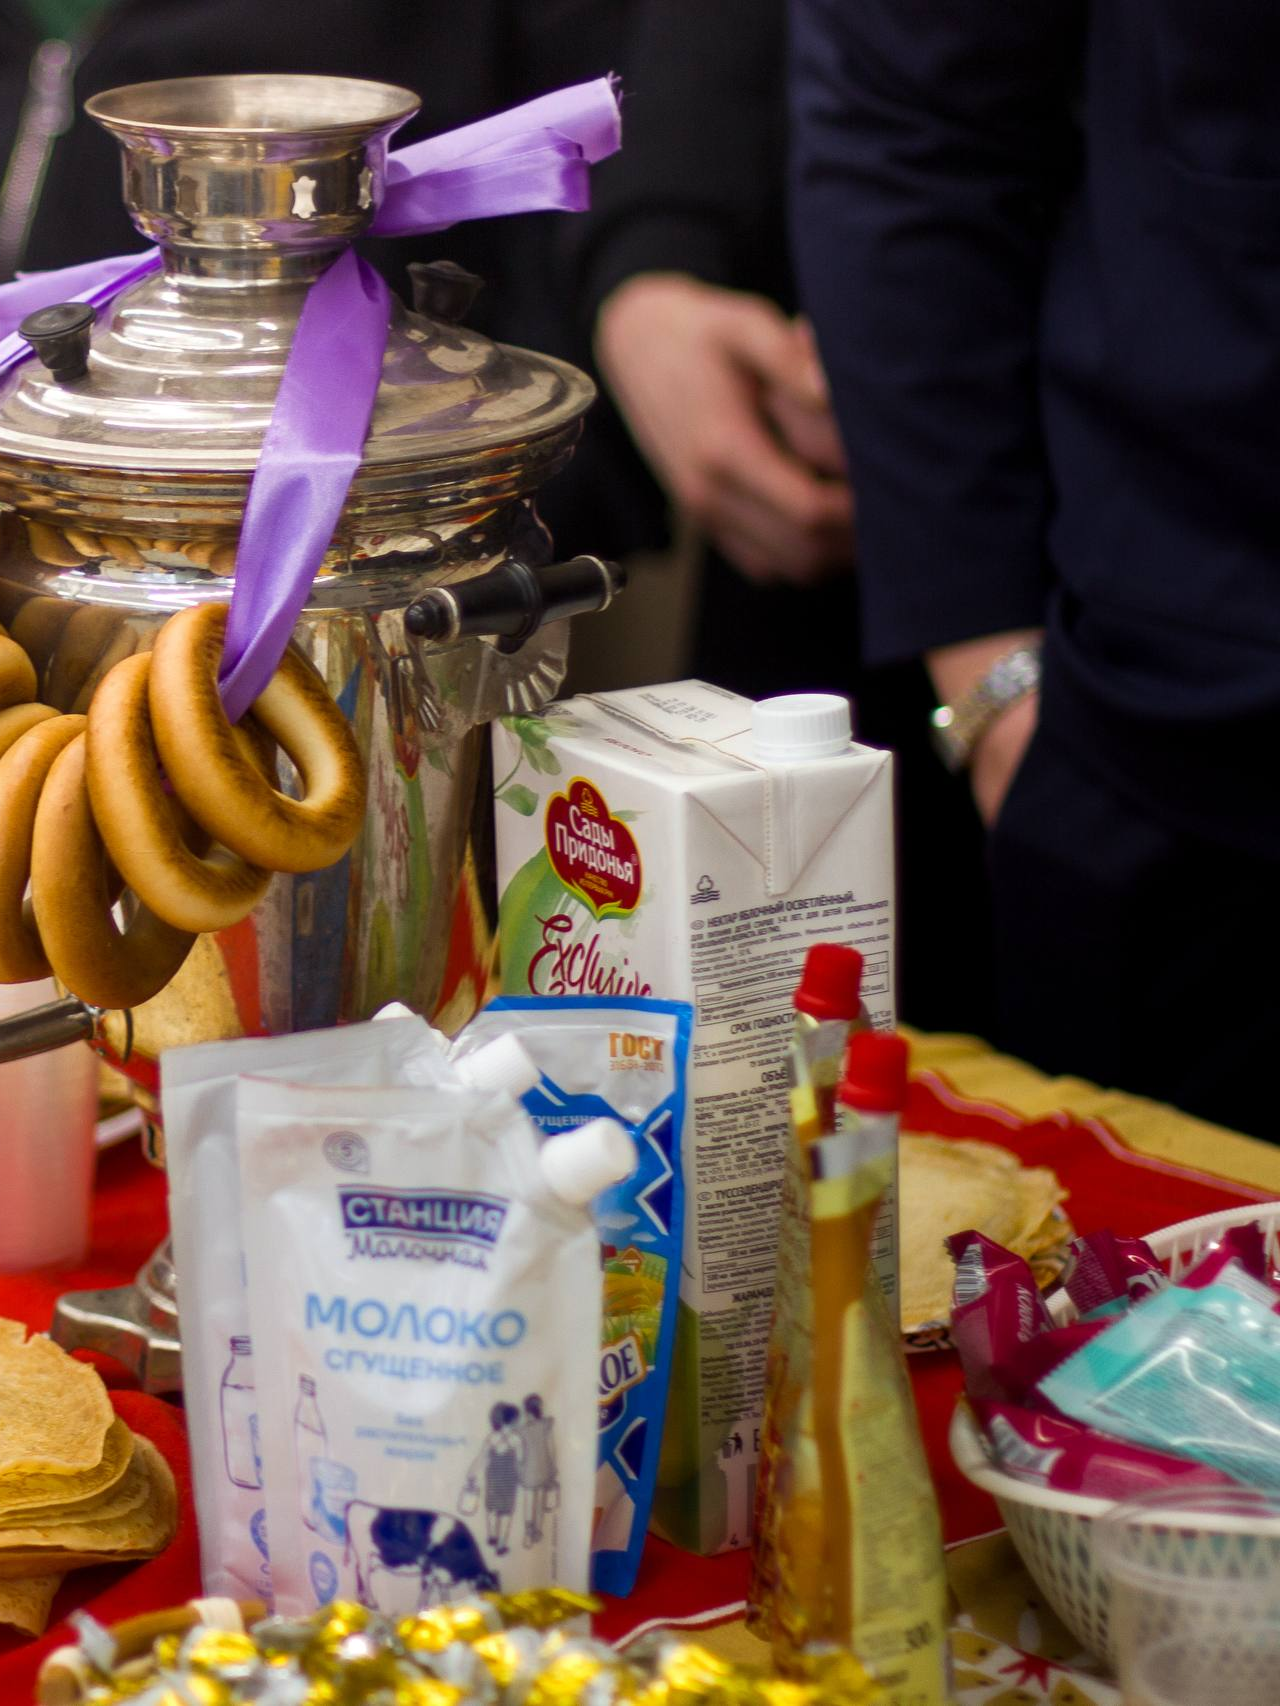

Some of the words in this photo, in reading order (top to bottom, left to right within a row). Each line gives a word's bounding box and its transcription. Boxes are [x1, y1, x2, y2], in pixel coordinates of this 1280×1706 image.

[568, 805, 615, 850] Сады
[555, 822, 634, 885] Придонья
[707, 912, 738, 929] НЕКТАР
[739, 900, 785, 921] ЯБЛОЧНЫЙ
[786, 890, 857, 912] ОСВЕТЛЁННЫЙ.
[608, 1032, 665, 1061] ГОСТ
[730, 1021, 752, 1034] СРОК
[761, 1065, 788, 1084] ОБЪЁ
[346, 1197, 504, 1239] СТАНЦИЯ
[345, 1230, 489, 1272] Молочная
[306, 1292, 528, 1349] МОЛОКО
[324, 1348, 506, 1386] СГУЩЕННОЕ
